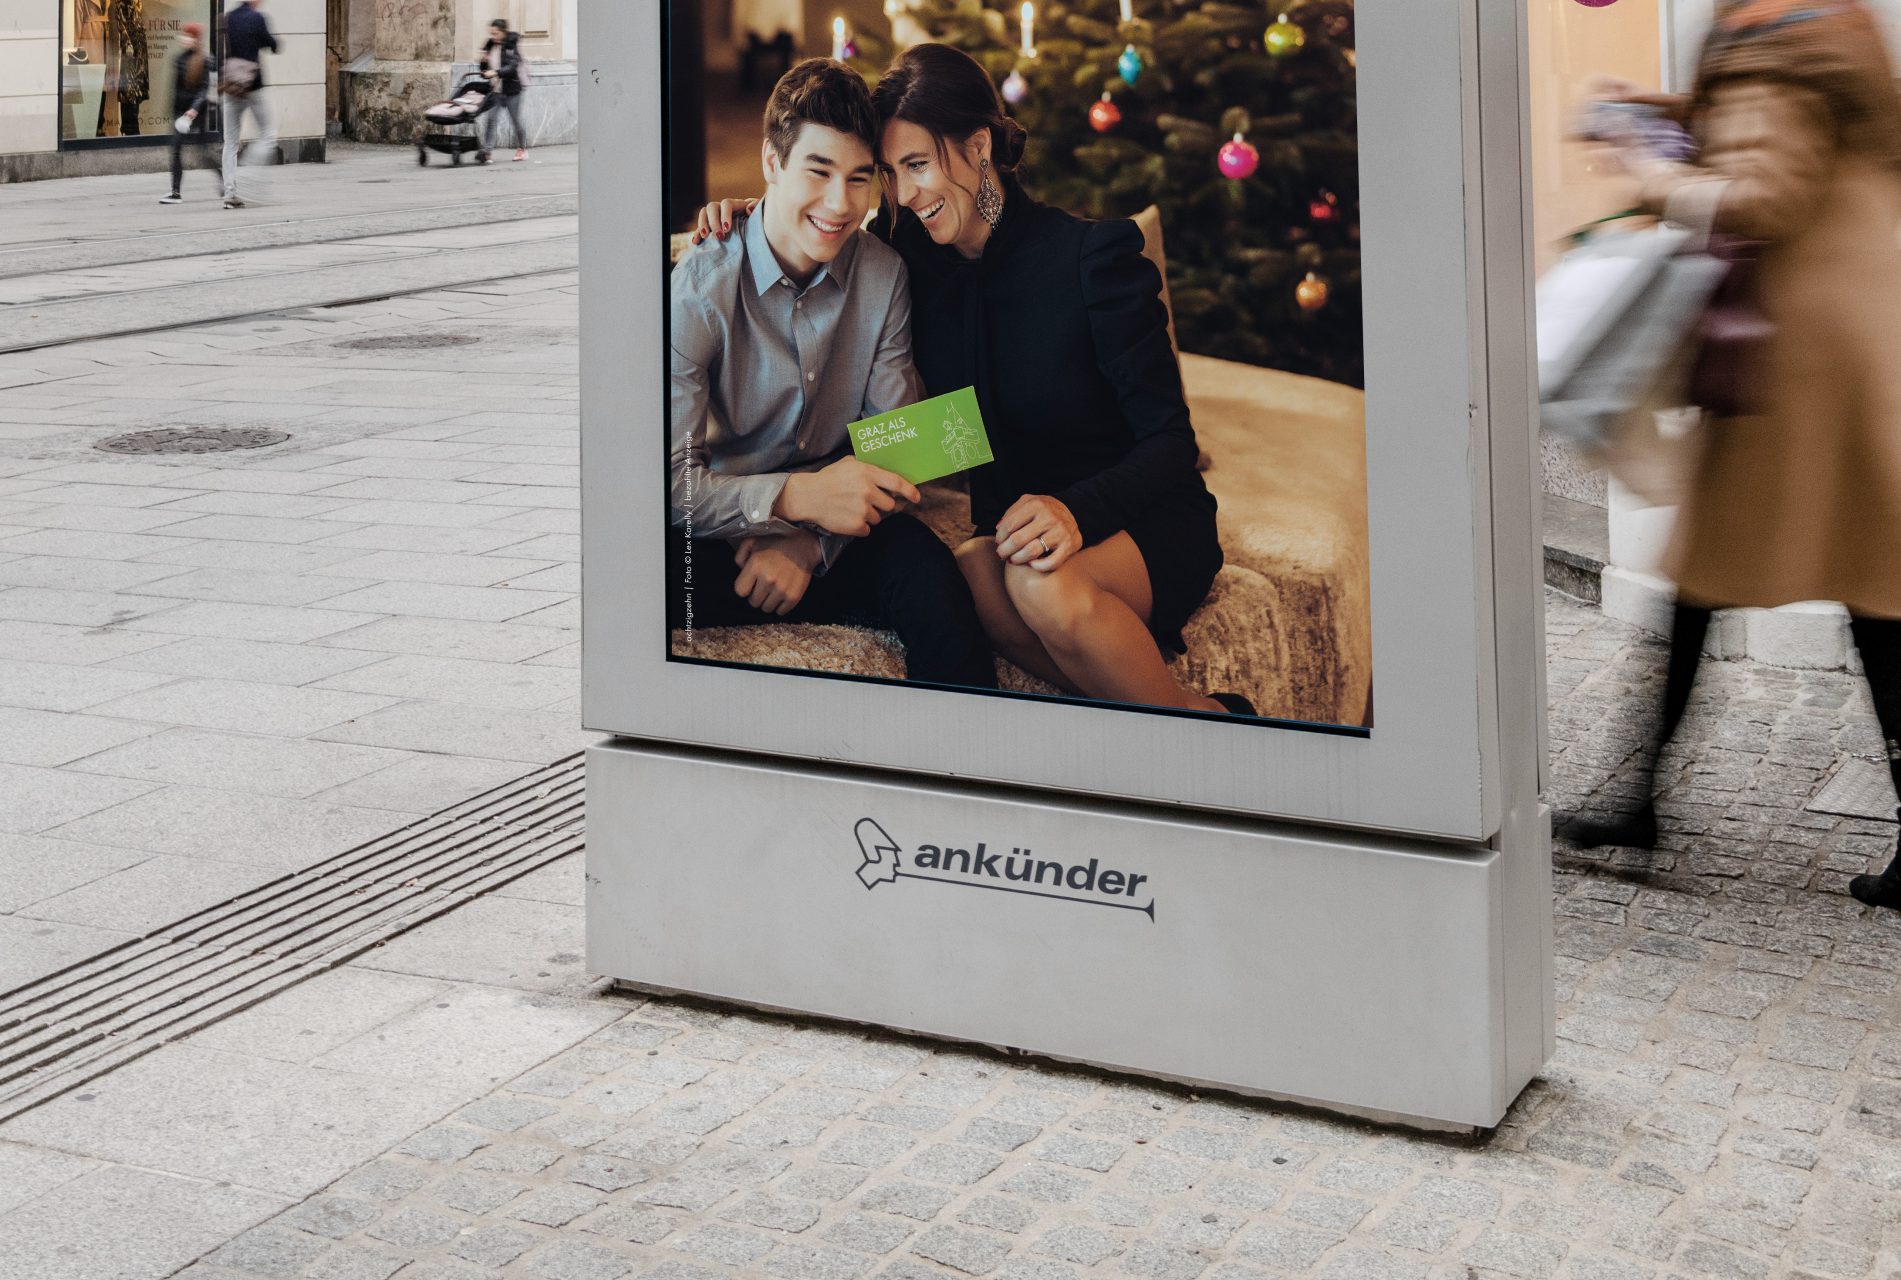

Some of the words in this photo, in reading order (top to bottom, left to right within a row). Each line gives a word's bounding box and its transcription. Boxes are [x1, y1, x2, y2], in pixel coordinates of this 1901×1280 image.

[857, 422, 887, 440] GRAZ
[888, 416, 906, 432] ALS
[860, 426, 918, 453] GESCHENK
[684, 431, 694, 465] Anzeige
[684, 466, 692, 501] bezahlte
[684, 510, 694, 539] Karelly
[684, 540, 692, 554] Lex
[684, 566, 692, 584] Foto
[684, 593, 694, 642] achtzigzehn
[914, 842, 1148, 897] ankünder
